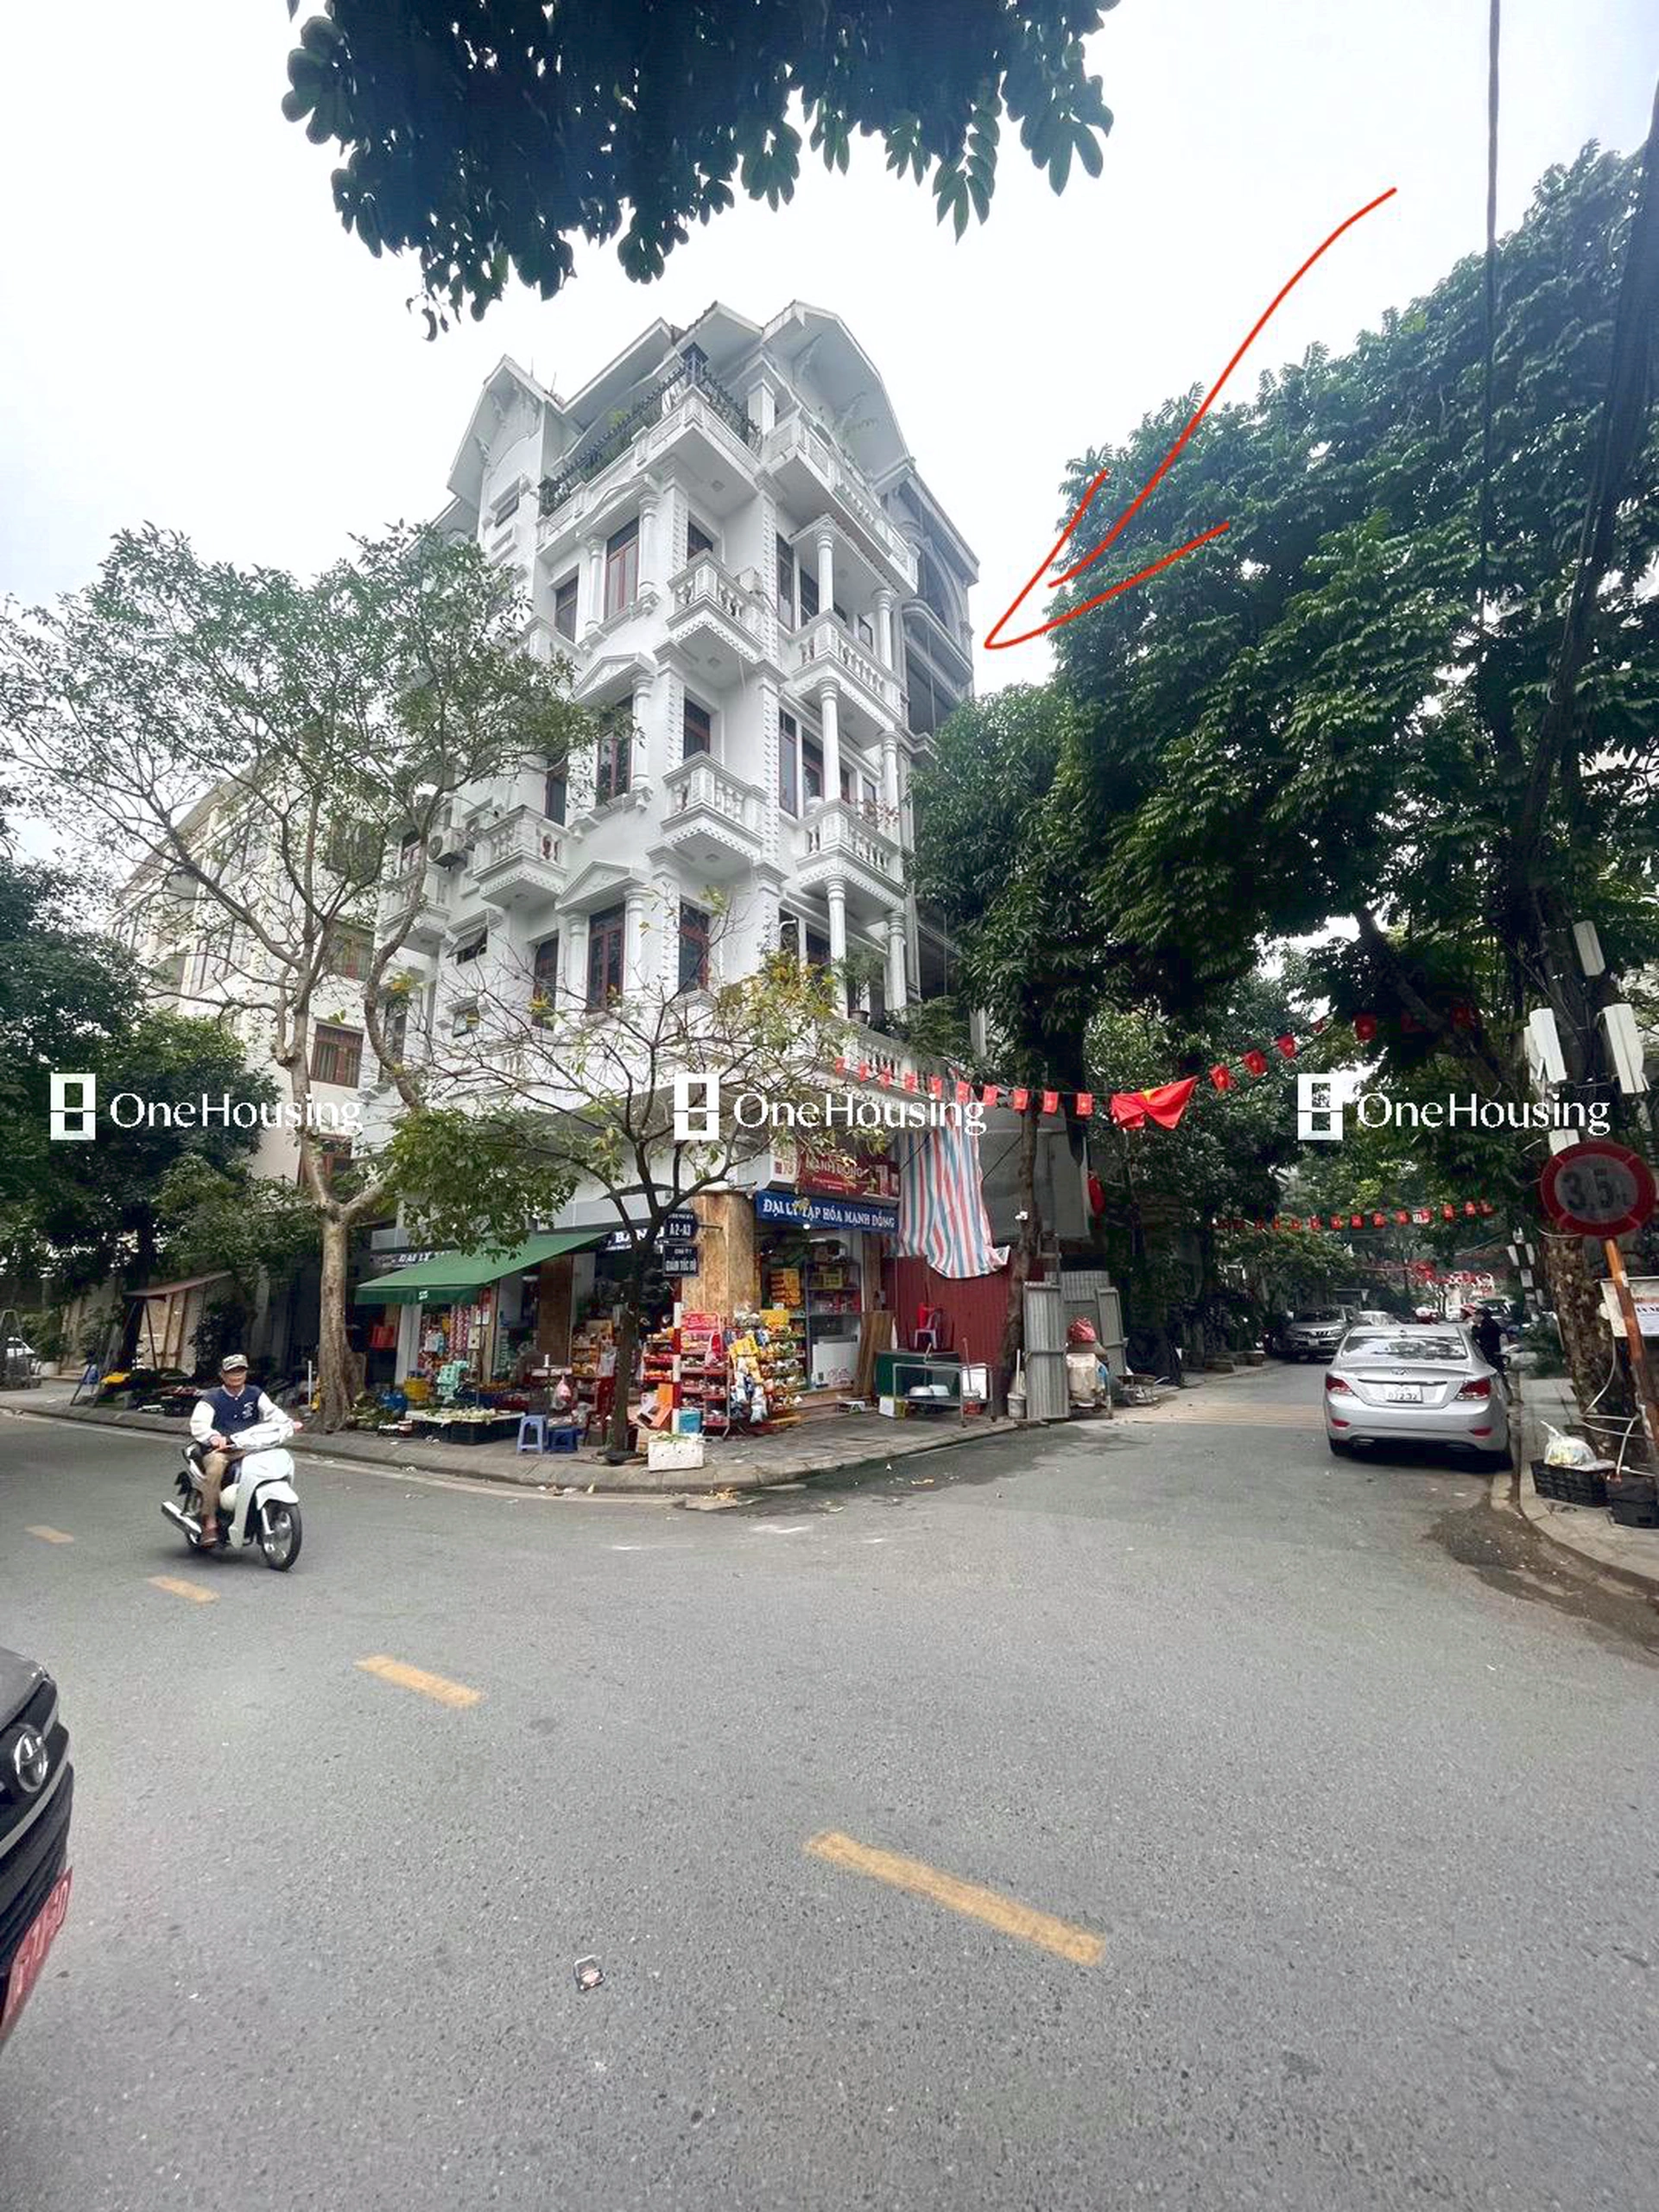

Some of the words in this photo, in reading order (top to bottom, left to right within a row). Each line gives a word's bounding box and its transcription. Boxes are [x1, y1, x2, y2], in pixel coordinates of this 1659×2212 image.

[763, 1198, 784, 1217] ĐẠI
[822, 1205, 843, 1221] HÓA
[845, 1211, 870, 1226] MẠNH
